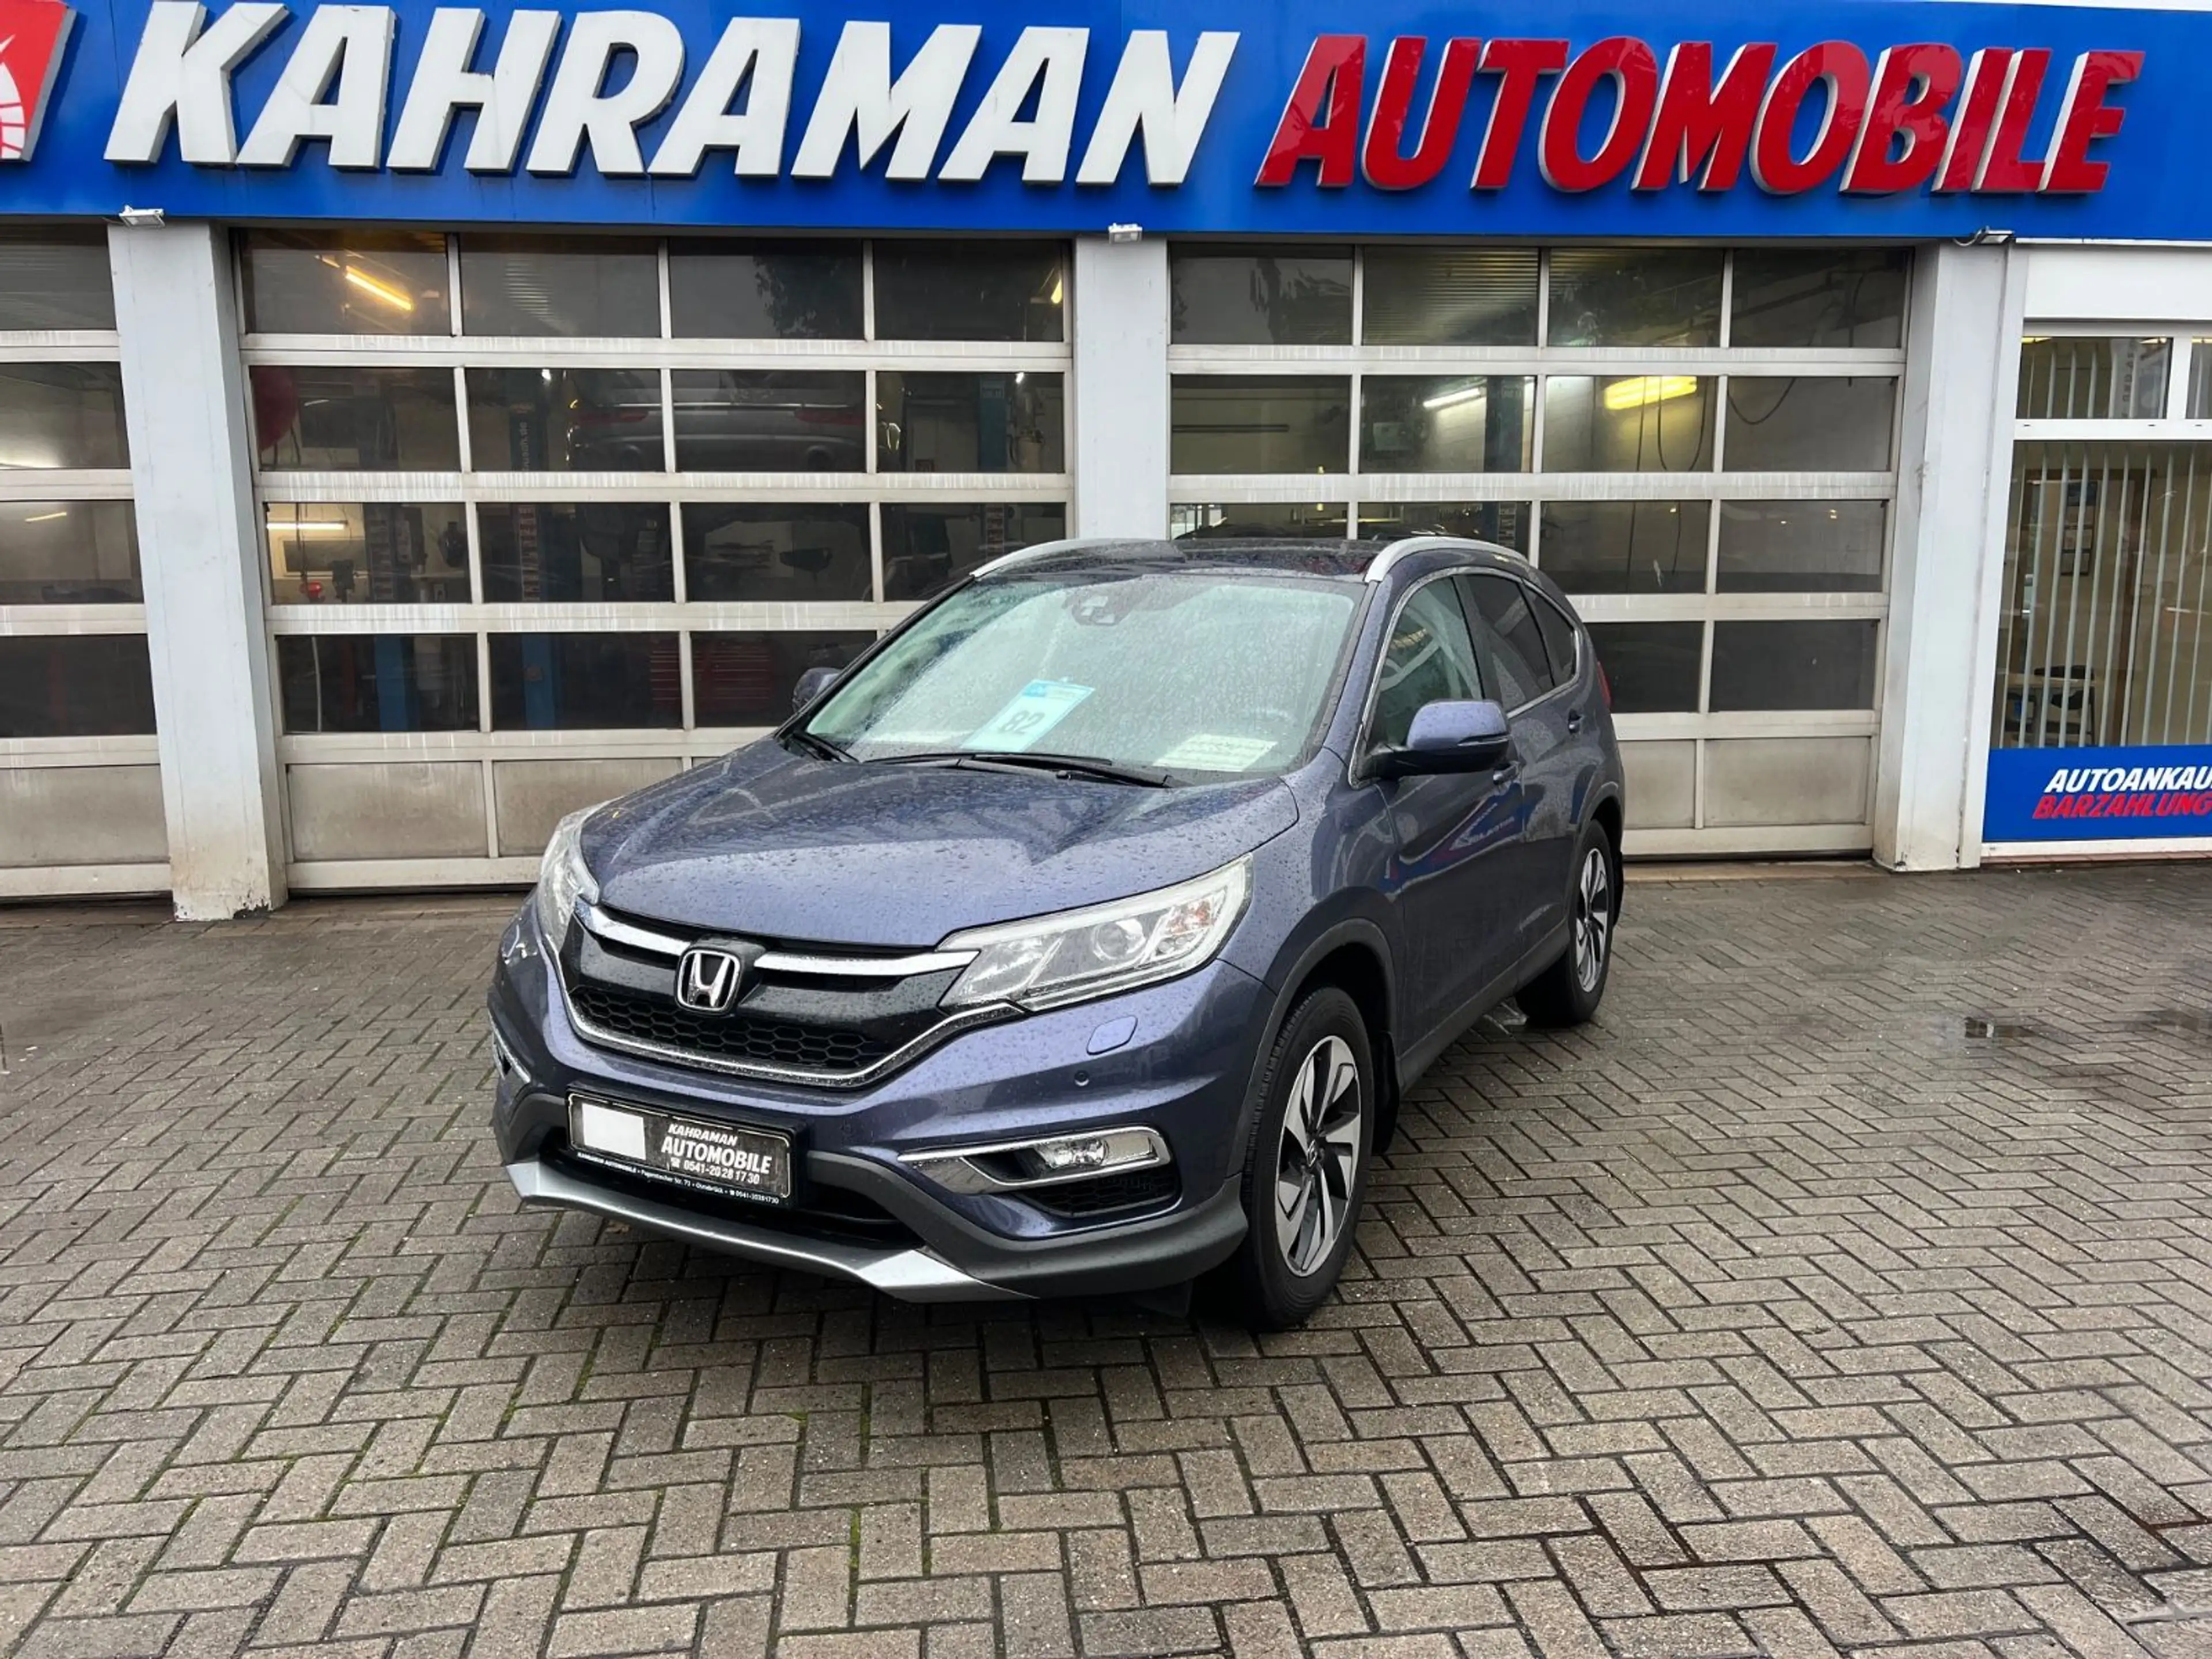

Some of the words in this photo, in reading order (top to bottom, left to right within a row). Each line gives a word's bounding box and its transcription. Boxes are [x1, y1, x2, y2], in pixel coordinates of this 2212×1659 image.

[104, 1, 1240, 185] KAHRAMAN
[1253, 35, 2145, 194] AUTOMOBILE
[998, 710, 1046, 734] 82
[2032, 792, 2212, 819] BARZAHLUNG
[668, 1124, 738, 1146] KAHRAMAN
[661, 1136, 772, 1175] AUTOMOBILE
